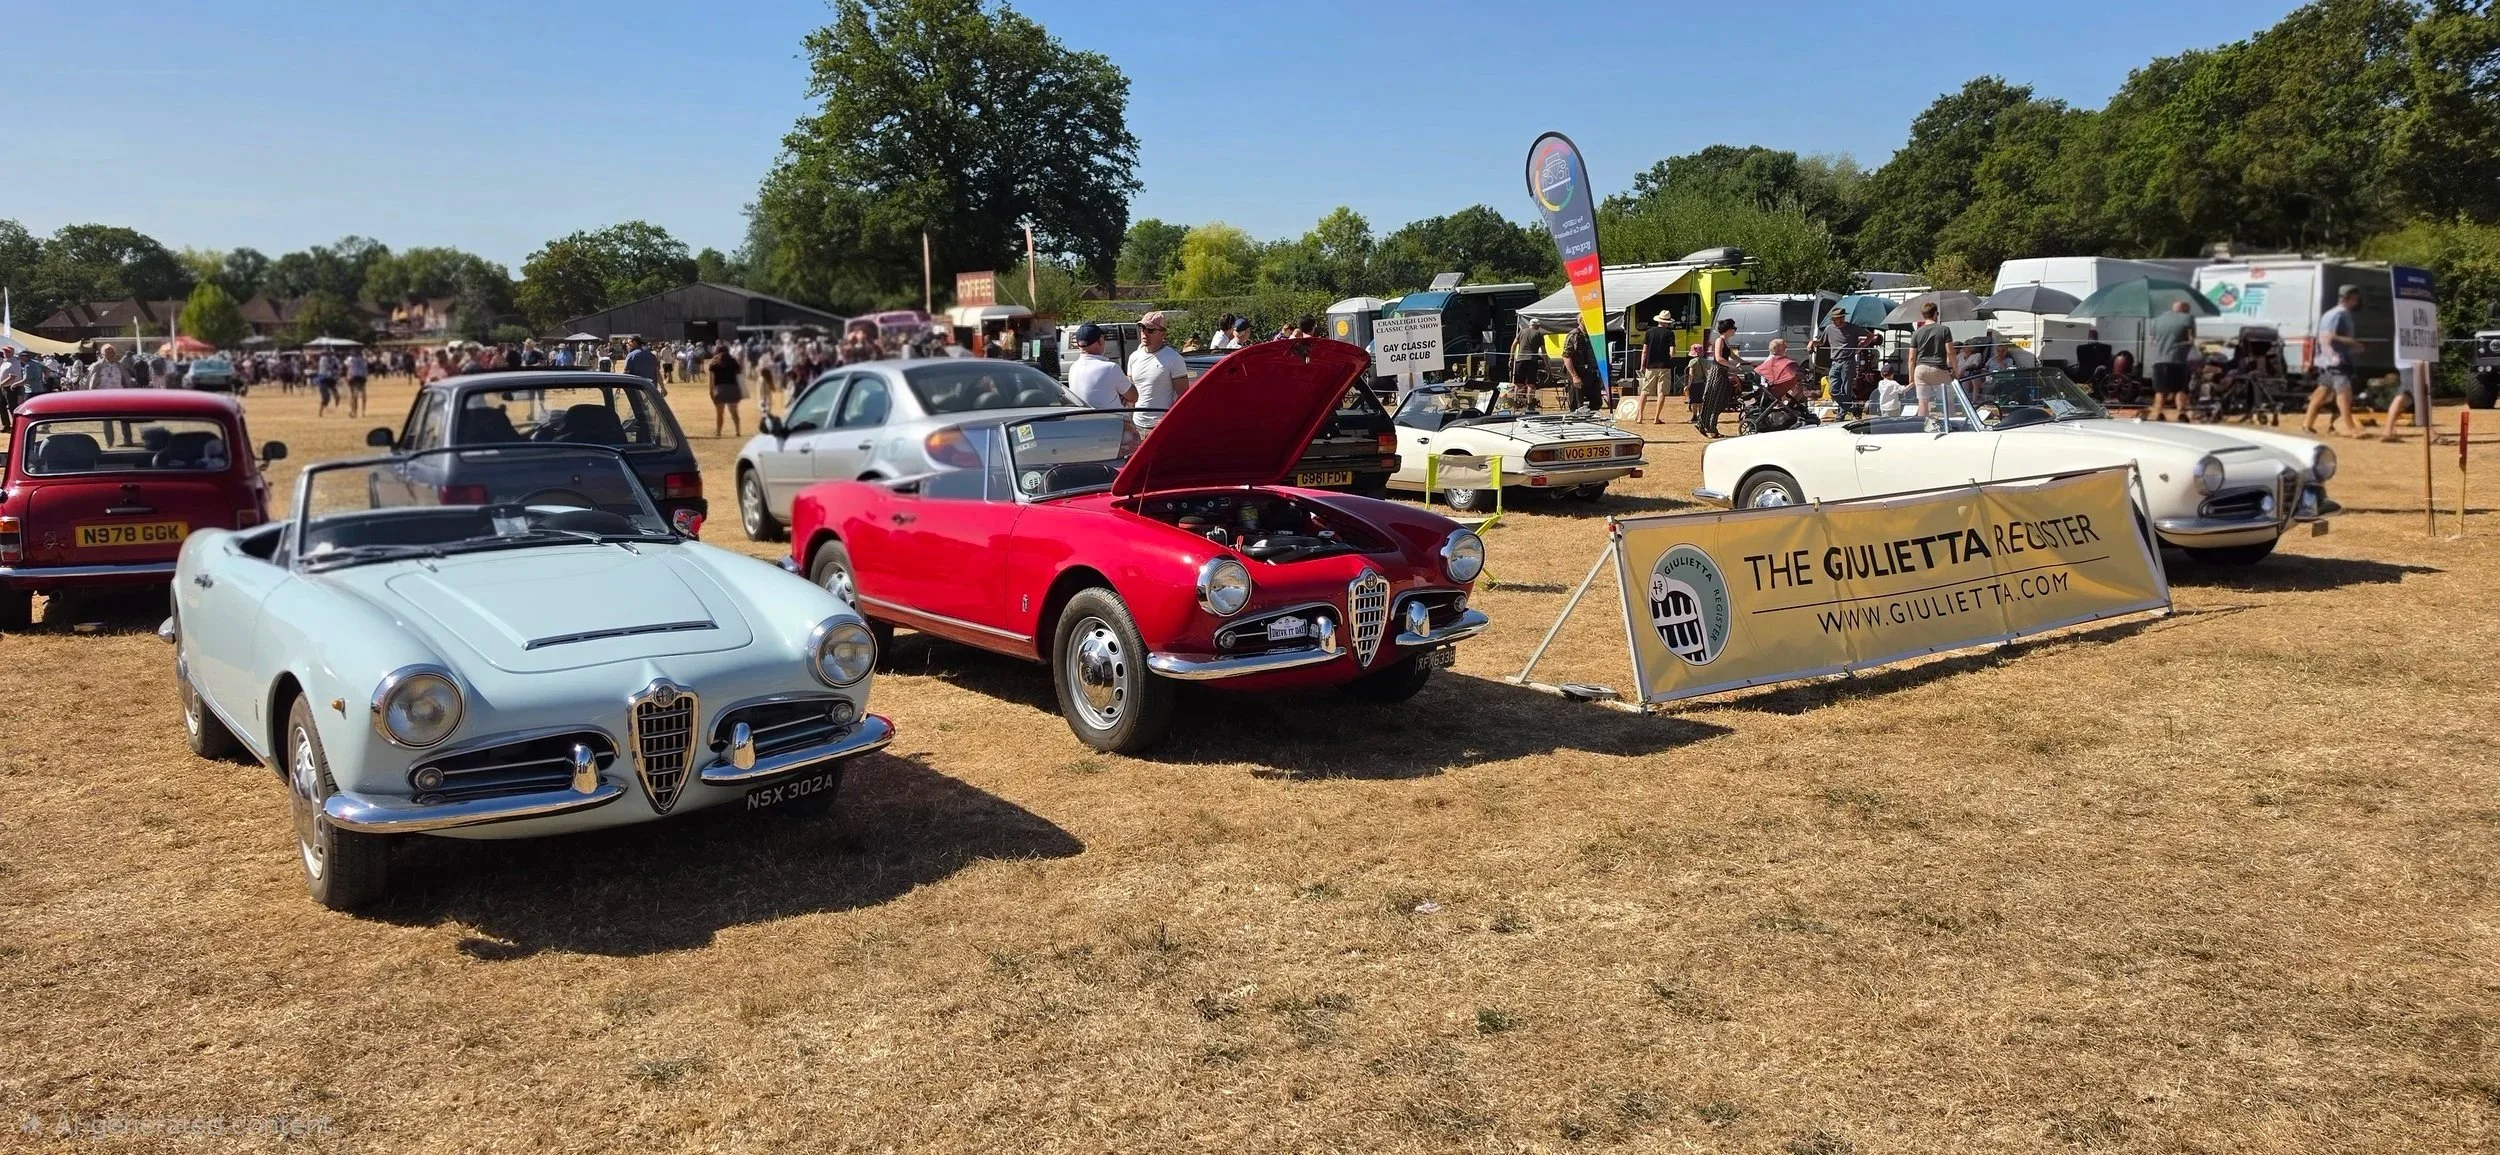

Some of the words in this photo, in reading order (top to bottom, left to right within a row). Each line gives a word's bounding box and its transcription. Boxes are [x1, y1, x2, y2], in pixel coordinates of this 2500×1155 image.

[959, 278, 991, 298] COFFEE
[1376, 326, 1404, 334] CLASSIC
[1419, 322, 1440, 330] SHOW
[1378, 318, 1416, 327] CRANLEIGH
[1417, 316, 1437, 324] LIONS
[1383, 343, 1400, 353] GAY
[1401, 339, 1437, 351] CLASSIC
[1390, 353, 1407, 363] CAR
[1409, 350, 1431, 361] CLUB
[1565, 448, 1585, 460] VOG
[1586, 446, 1610, 458] 379S
[84, 526, 136, 545] N978
[142, 524, 179, 541] GGK
[1744, 550, 1813, 591] THE
[1823, 528, 1992, 581] GIULIETTA
[1993, 514, 2100, 556] REGISTER
[1664, 557, 1712, 582] GIULIETTA
[1817, 572, 2068, 634] WWW.GIULIETTA.COM
[1709, 588, 1723, 642] REGISTER
[1272, 628, 1288, 638] DRIVE
[1289, 627, 1294, 636] IT
[747, 785, 785, 811] NSX
[788, 774, 833, 799] 302A
